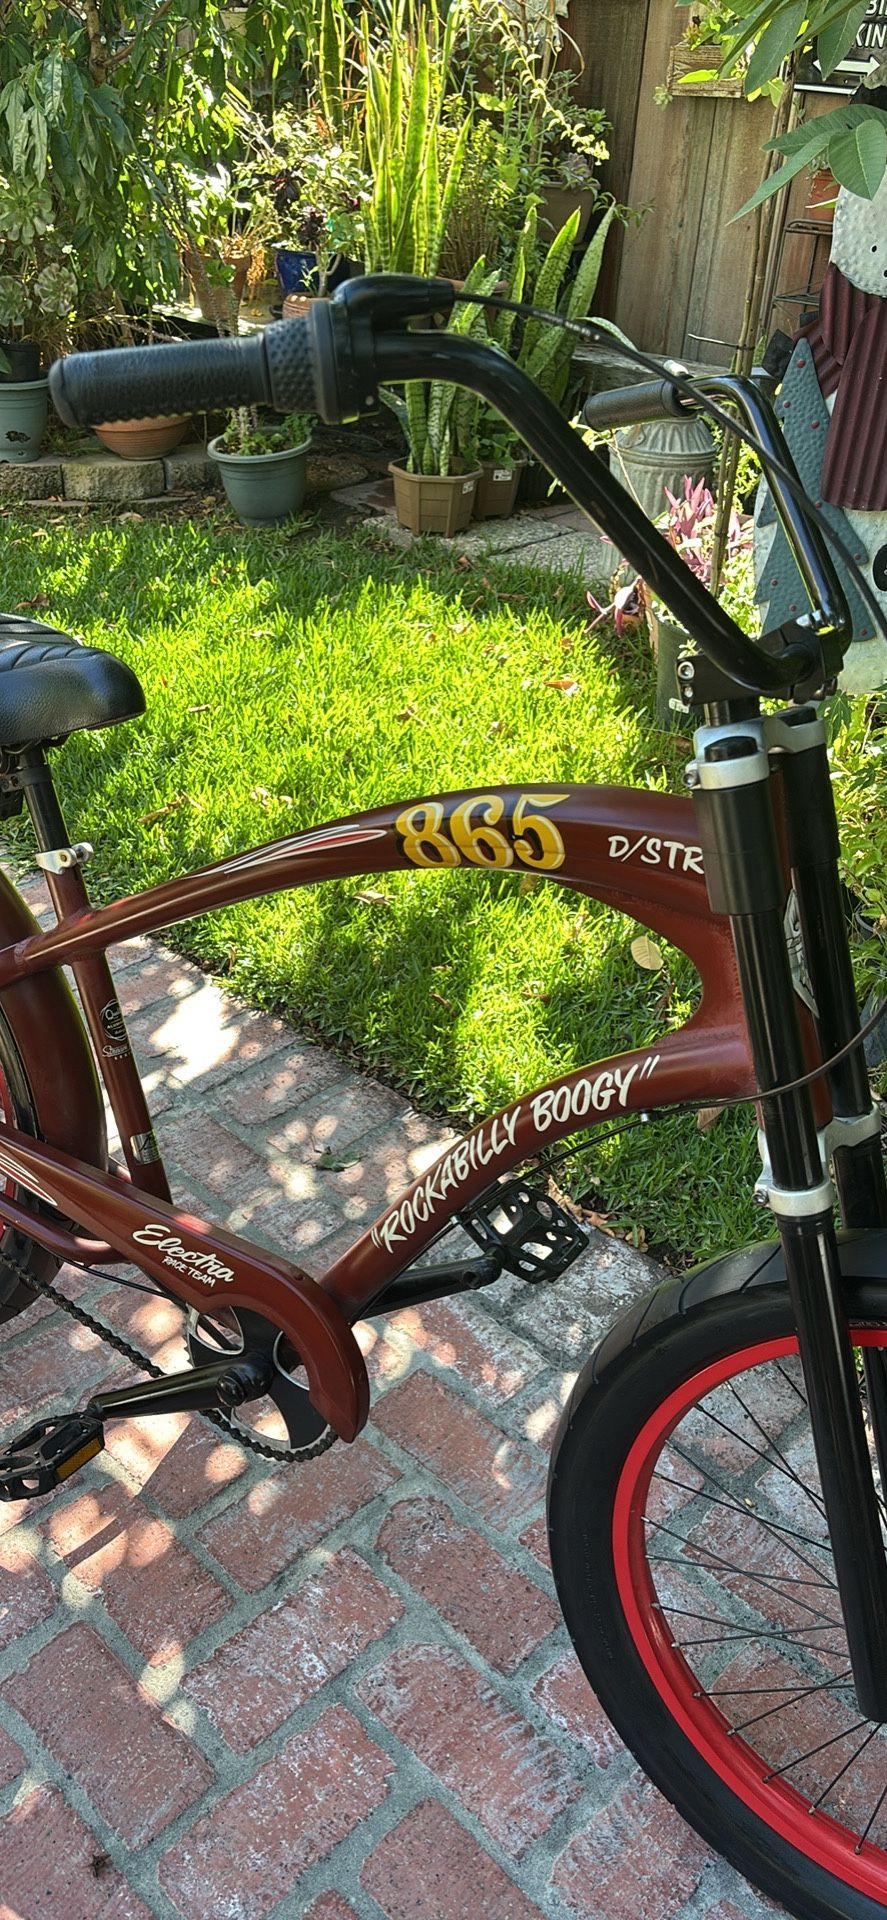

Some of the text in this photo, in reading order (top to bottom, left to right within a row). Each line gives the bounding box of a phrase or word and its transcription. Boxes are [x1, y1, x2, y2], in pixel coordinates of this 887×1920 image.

[395, 793, 571, 870] 865
[132, 1223, 235, 1282] Electra
[161, 1255, 217, 1288] RACE TEAM
